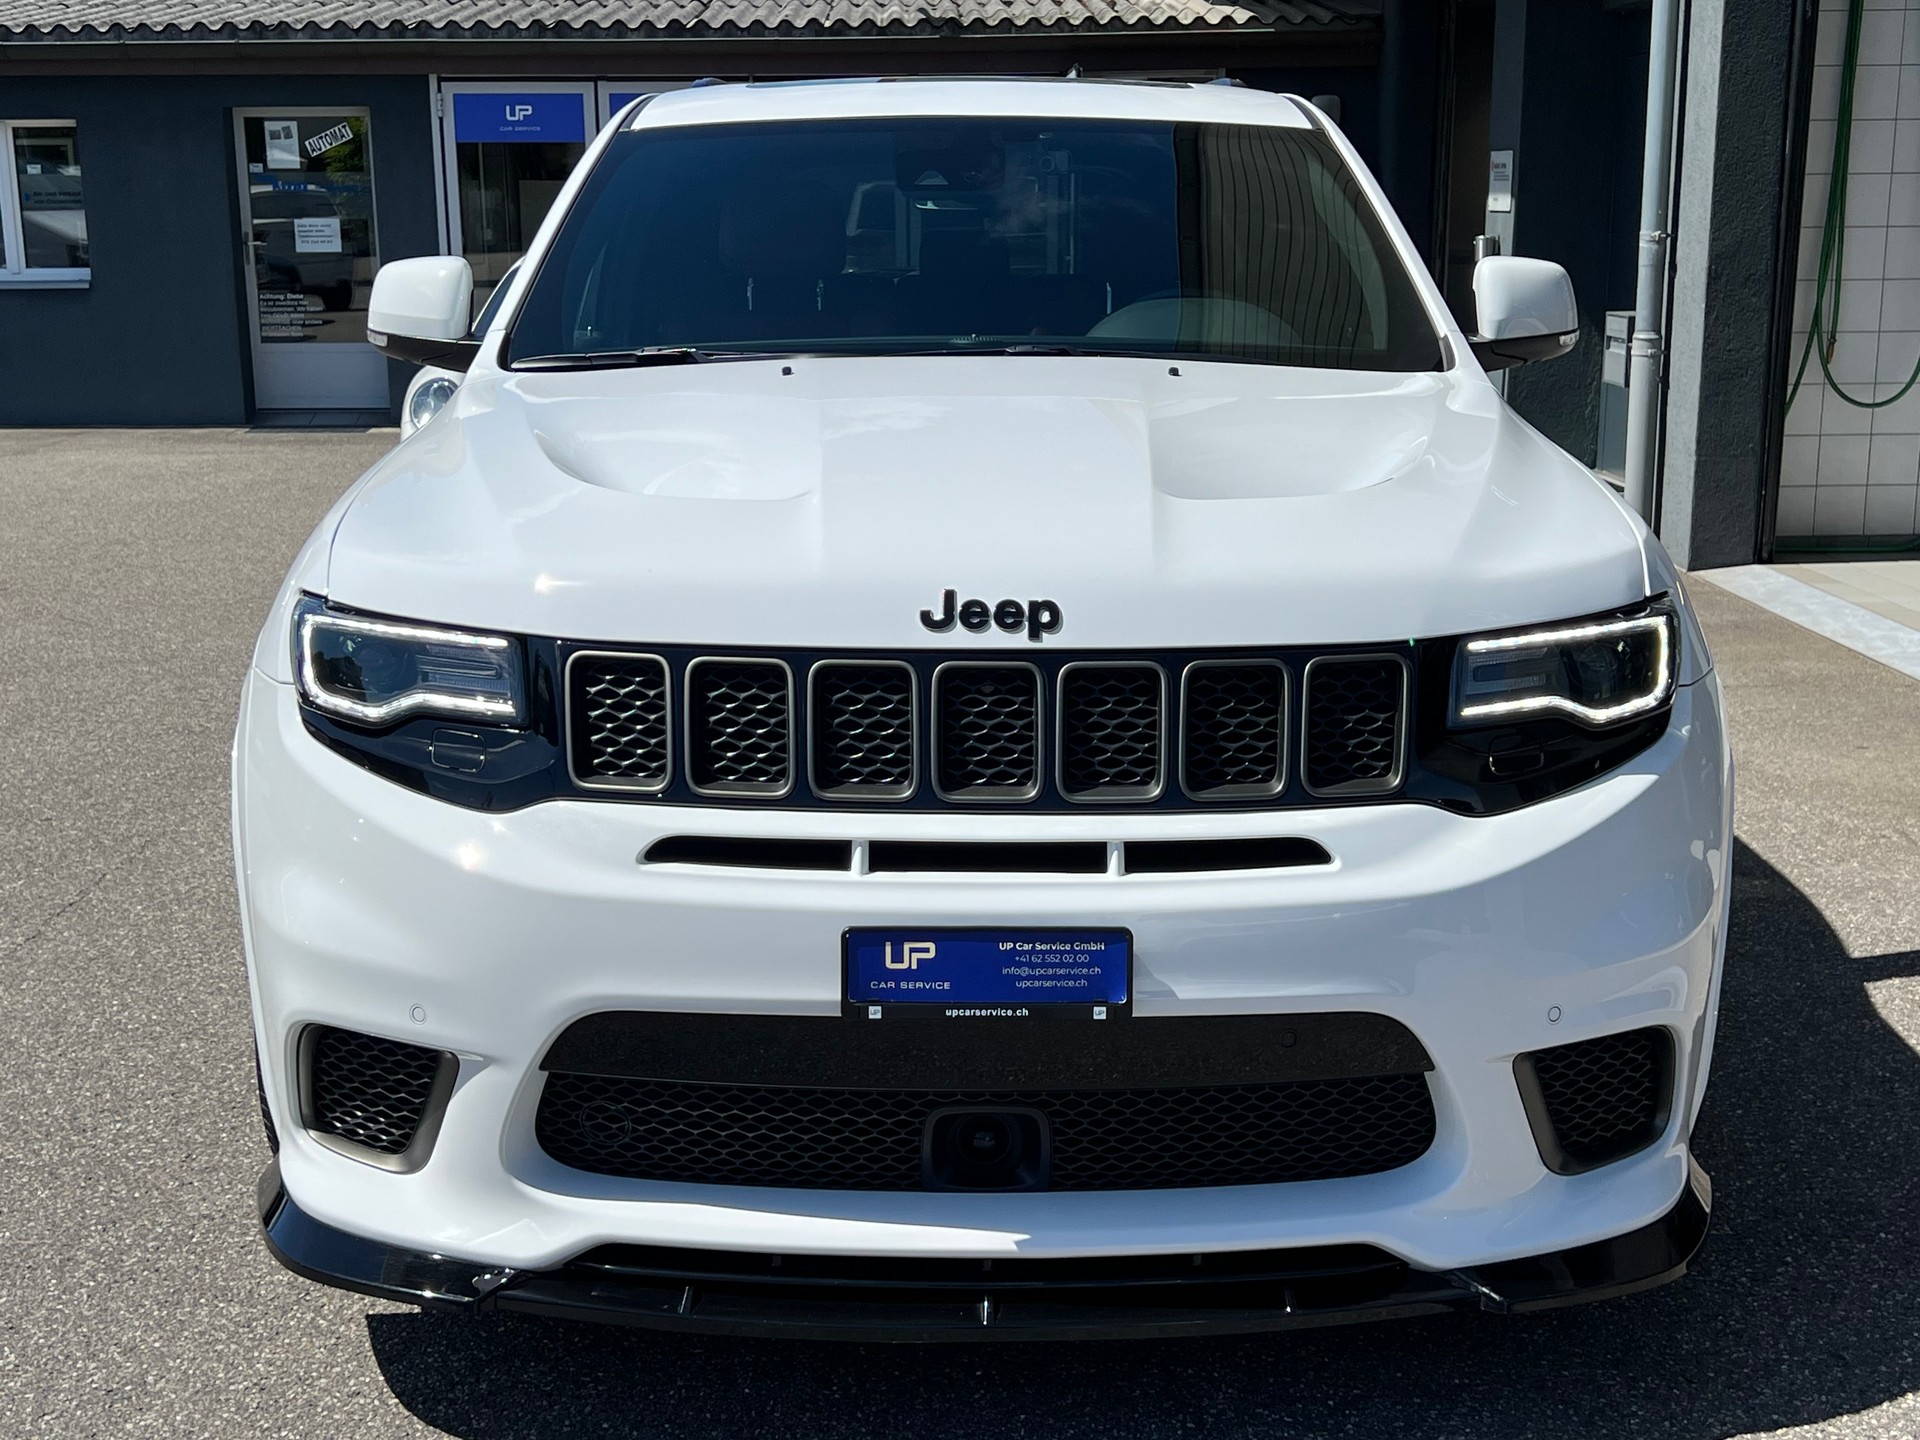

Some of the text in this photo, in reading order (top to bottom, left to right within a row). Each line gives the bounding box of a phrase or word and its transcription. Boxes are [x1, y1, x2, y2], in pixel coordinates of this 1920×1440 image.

[505, 104, 533, 121] UP
[307, 124, 351, 155] AUTOMAT
[920, 589, 1062, 642] Jeep
[999, 941, 1105, 951] UP Car Service GmbH
[885, 941, 936, 970] UP
[1015, 954, 1090, 963] +41 62 552 02 00
[1002, 966, 1102, 977] info@upcarservice.ch
[870, 981, 951, 990] CAR SERVICE
[1015, 979, 1088, 989] upcarservice.ch
[945, 1007, 1029, 1018] upcarservice.ch
